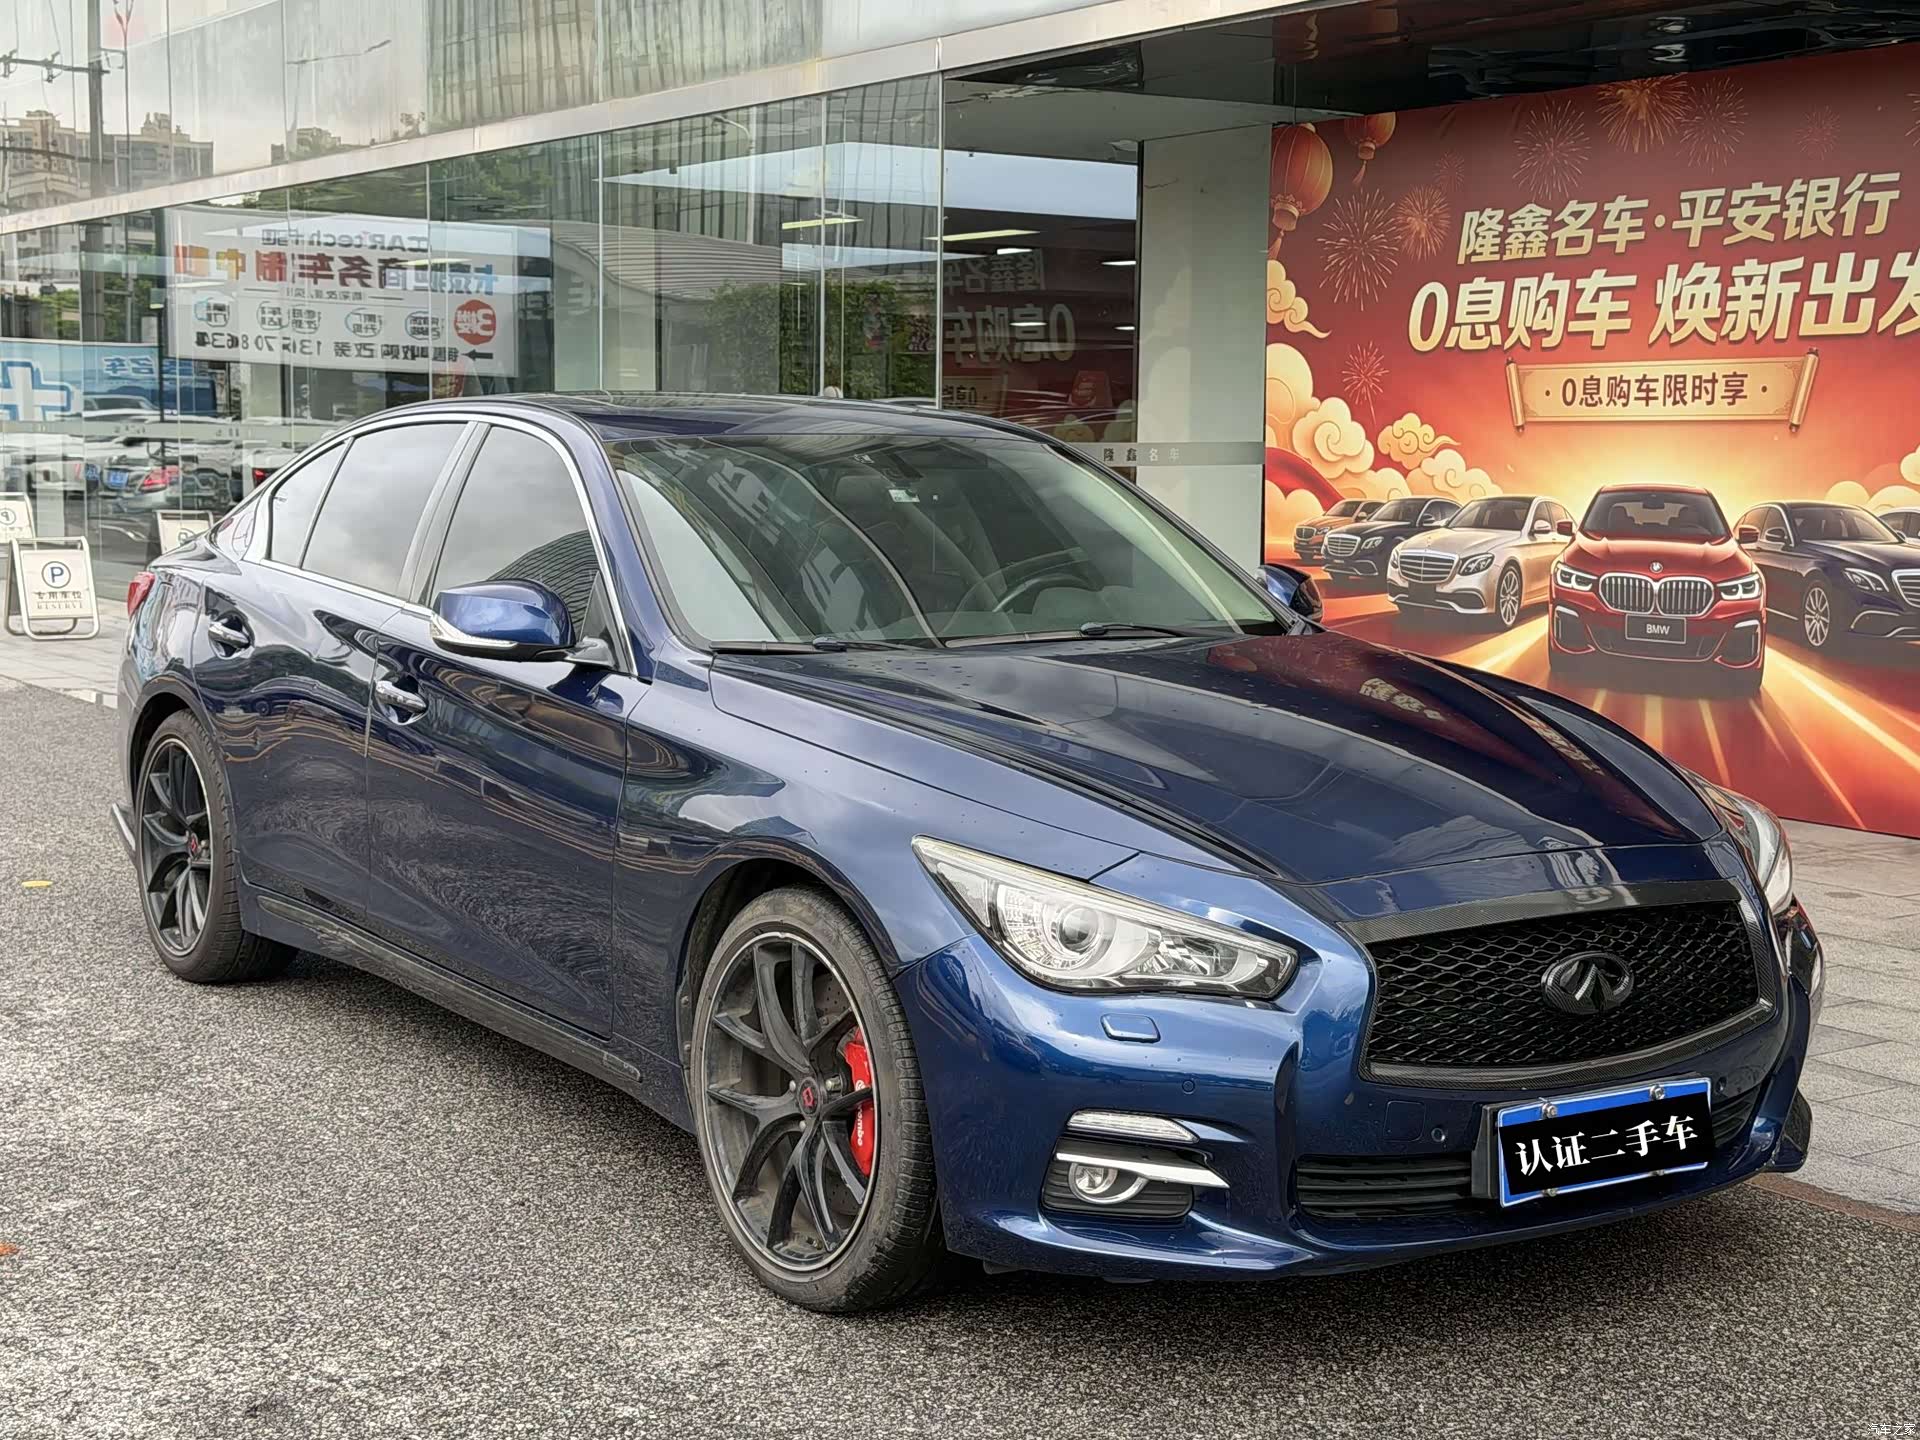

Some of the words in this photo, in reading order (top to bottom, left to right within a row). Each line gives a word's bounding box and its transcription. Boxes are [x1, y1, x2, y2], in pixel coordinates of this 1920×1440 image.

[1457, 172, 1901, 265] 隆鑫名车·平安银行
[1407, 269, 1637, 352] 0息购车
[1561, 372, 1749, 408] 0息购车限时享
[50, 566, 64, 583] P
[1646, 623, 1670, 636] BMW
